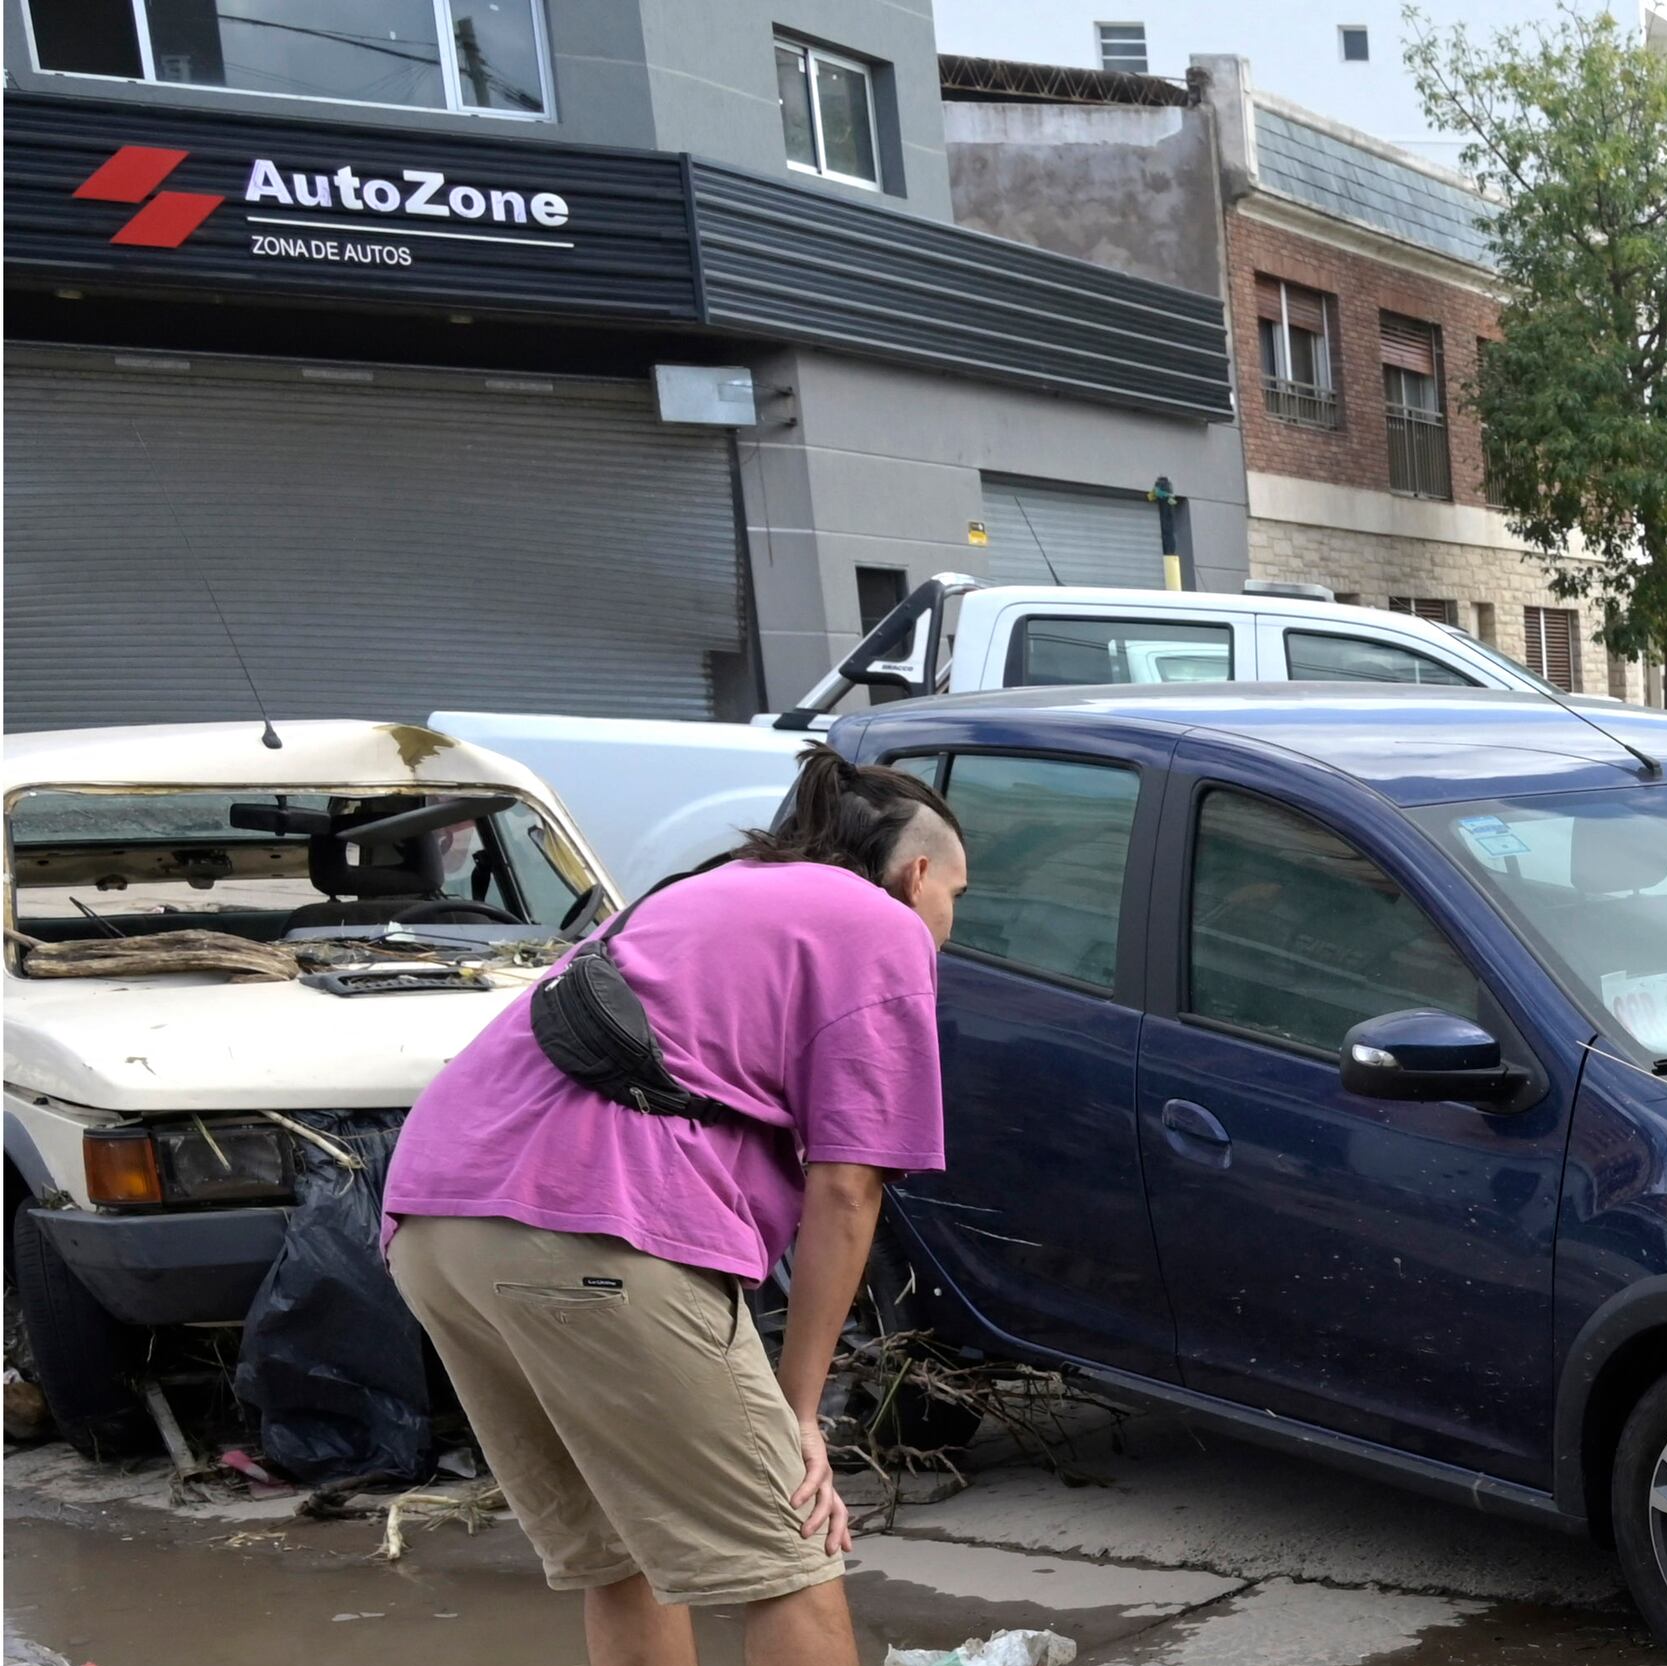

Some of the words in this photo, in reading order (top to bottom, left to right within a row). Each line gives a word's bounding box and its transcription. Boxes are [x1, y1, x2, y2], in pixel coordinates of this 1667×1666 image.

[245, 158, 570, 227] AutoZone
[251, 235, 307, 258] ZONA
[311, 240, 340, 260] DE
[343, 243, 412, 266] AUTOS
